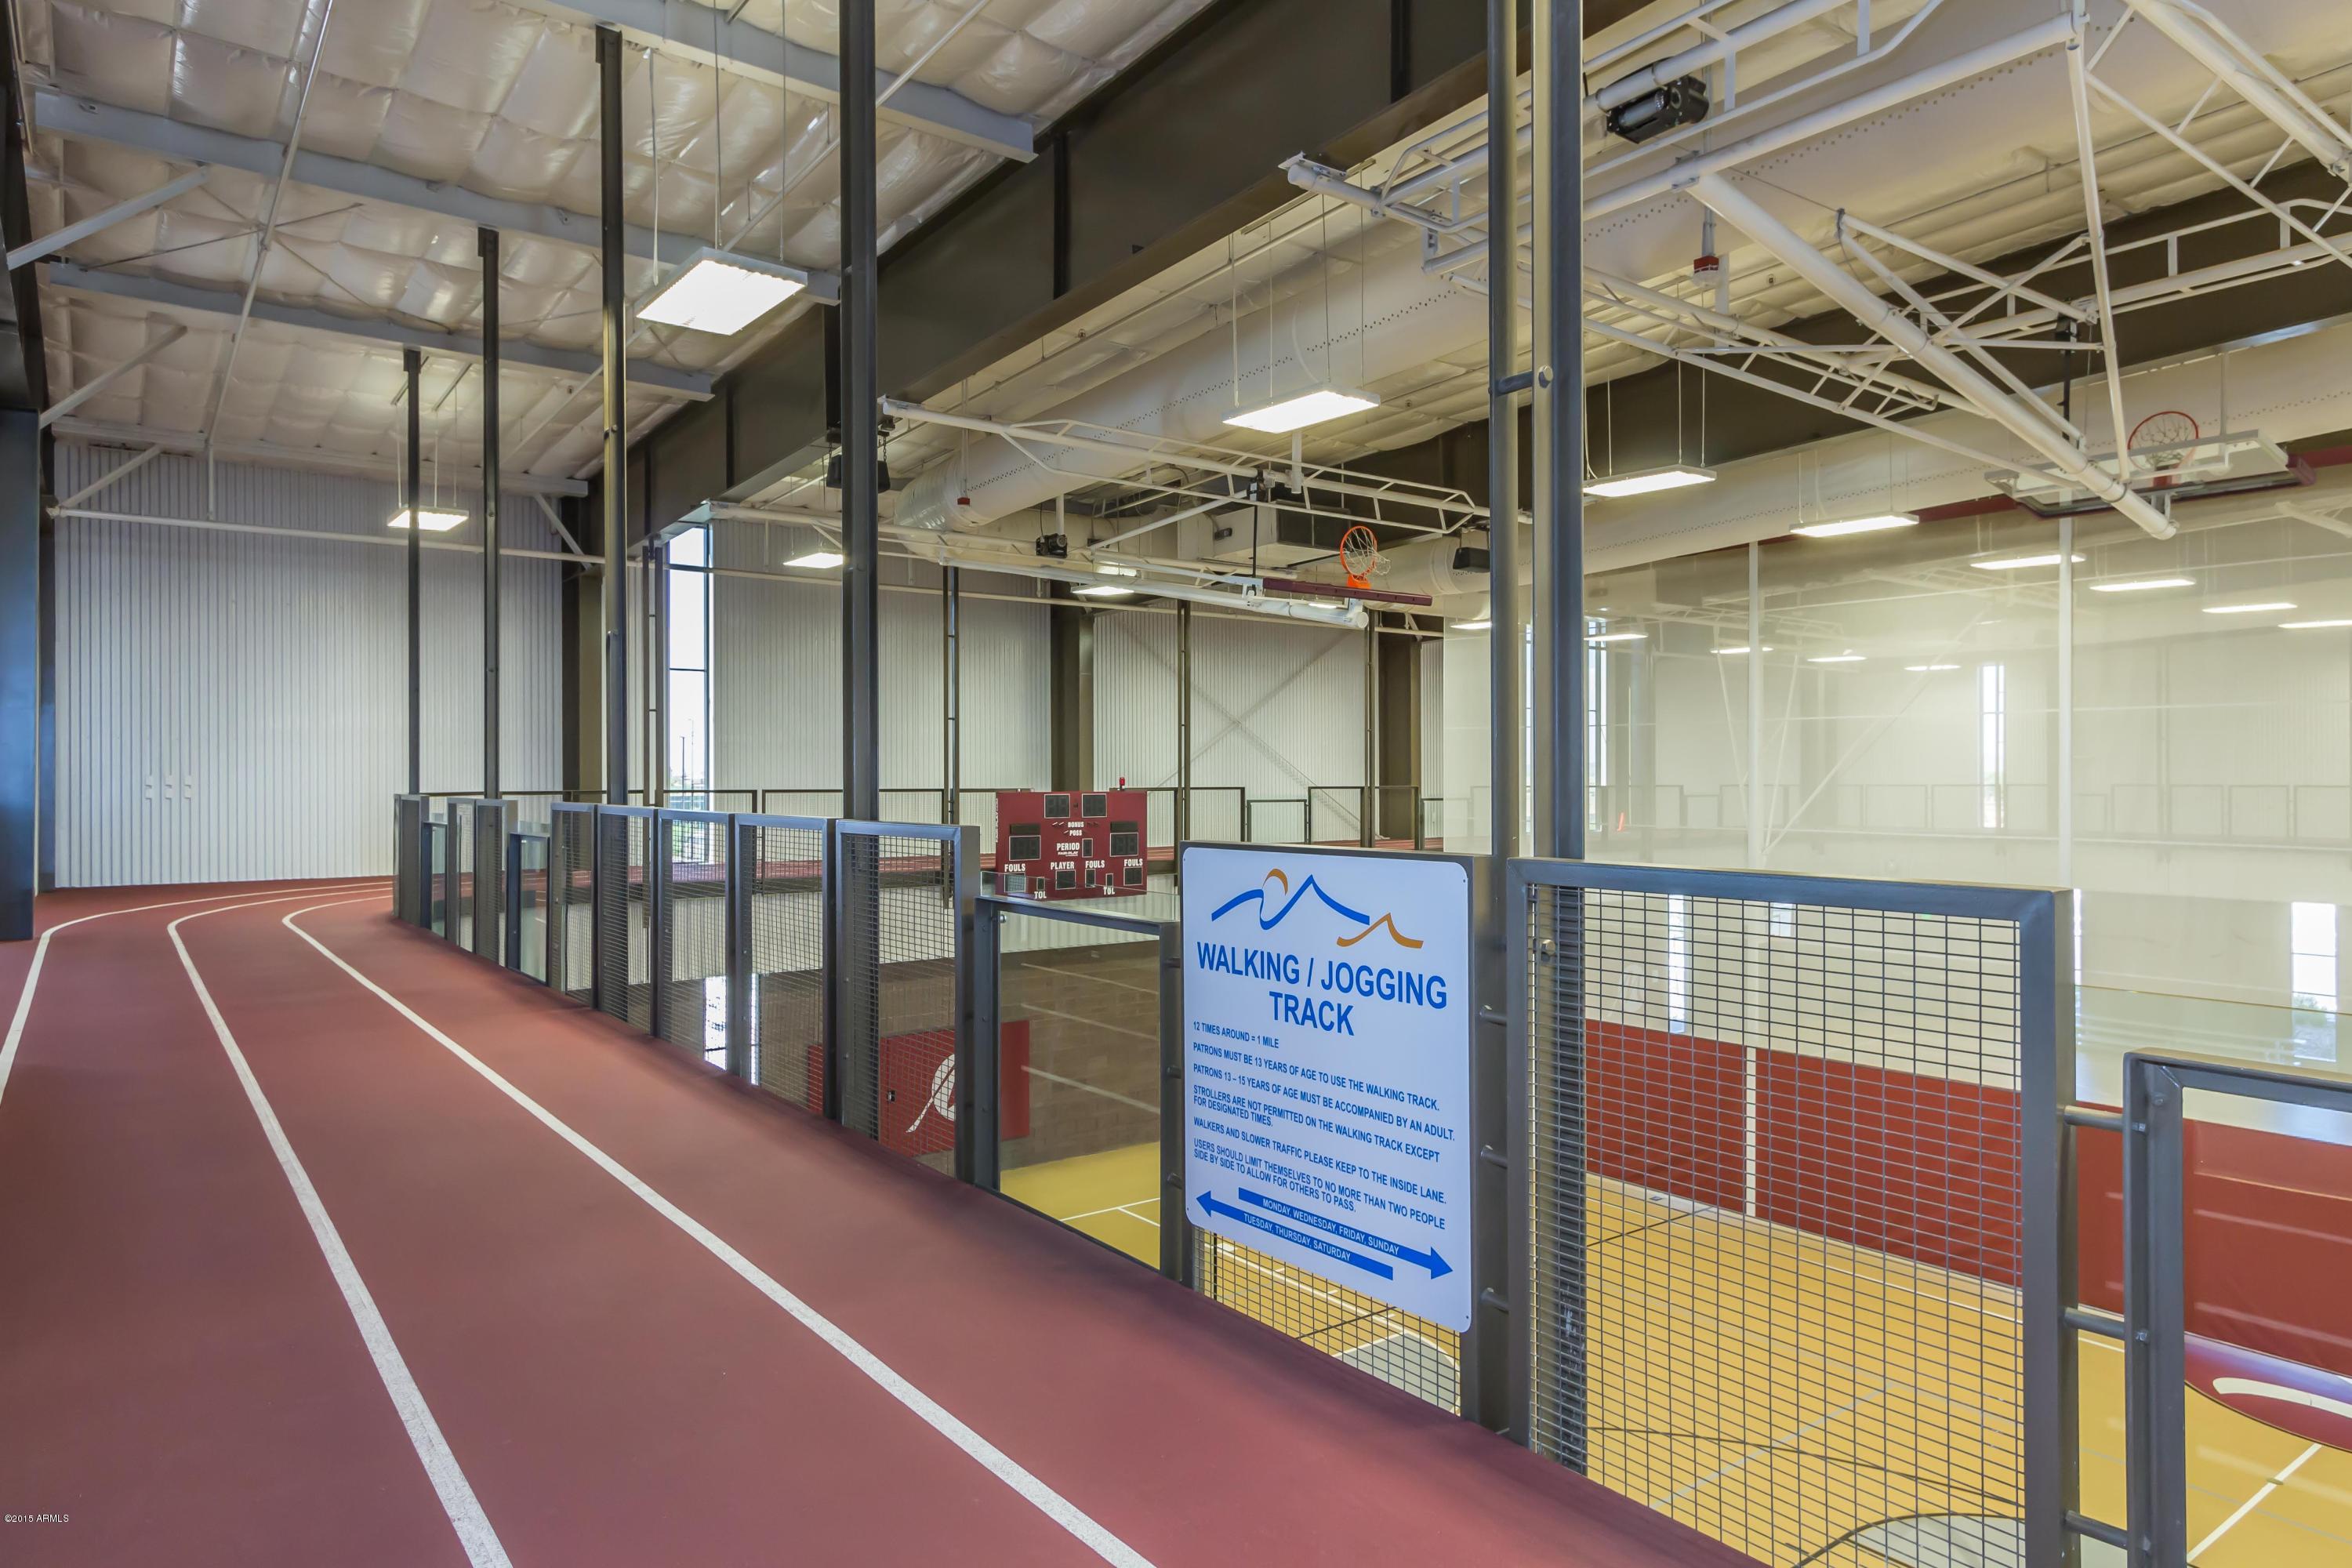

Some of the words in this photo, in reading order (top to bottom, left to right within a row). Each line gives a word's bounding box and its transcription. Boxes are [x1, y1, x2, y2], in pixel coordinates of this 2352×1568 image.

[1004, 863, 1025, 873] FOULS
[1051, 861, 1075, 870] PLAYER
[1056, 842, 1080, 851] PERIOD
[1085, 860, 1105, 869] FOULS
[1124, 858, 1143, 867] FOULS
[1034, 891, 1047, 899] TOL
[1197, 942, 1300, 985] WALKING
[1307, 957, 1314, 987] /
[1321, 960, 1446, 1009] JOGGING
[1193, 1022, 1200, 1031] 12
[1202, 1023, 1220, 1035] TIMES
[1221, 1027, 1250, 1042] AROUND
[1258, 1036, 1261, 1044] 1
[1263, 1036, 1279, 1048] MILE
[1269, 991, 1355, 1036] TRACK
[1193, 1042, 1222, 1058] PATRONS
[1224, 1050, 1242, 1063] MUST
[1244, 1054, 1253, 1065] BE
[1254, 1057, 1262, 1067] 13
[1264, 1059, 1287, 1073] YEARS
[1290, 1065, 1299, 1076] OF
[1301, 1068, 1316, 1080] AGE
[1319, 1072, 1329, 1083] TO
[1330, 1075, 1346, 1088] USE
[1348, 1079, 1363, 1092] THE
[1366, 1083, 1405, 1102] WALKING
[1407, 1093, 1439, 1111] TRACK.
[1193, 1064, 1222, 1079] PATRONS
[1225, 1072, 1232, 1082] 13
[1239, 1076, 1246, 1086] 15
[1247, 1077, 1270, 1091] YEARS
[1272, 1083, 1281, 1094] OF
[1283, 1087, 1298, 1099] AGE
[1301, 1091, 1321, 1105] MUST
[1323, 1097, 1333, 1109] BE
[1334, 1100, 1394, 1124] ACCOMPANIED
[1396, 1116, 1408, 1129] BY
[1410, 1119, 1422, 1132] AN
[1425, 1123, 1454, 1141] ADULT.
[1193, 1095, 1207, 1107] FOR
[1208, 1101, 1249, 1120] DESIGNATED
[1250, 1111, 1273, 1127] TIMES.
[1193, 1085, 1231, 1103] STROLLERS
[1232, 1095, 1246, 1108] ARE
[1247, 1100, 1261, 1112] NOT
[1264, 1104, 1304, 1123] PERMITTED
[1305, 1116, 1316, 1127] ON
[1319, 1119, 1333, 1132] THE
[1335, 1123, 1372, 1144] WALKING
[1374, 1134, 1403, 1152] TRACK
[1405, 1143, 1439, 1163] EXCEPT
[1194, 1116, 1225, 1134] WALKERS
[1225, 1127, 1240, 1139] AND
[1242, 1131, 1270, 1149] SLOWER
[1272, 1140, 1302, 1159] TRAFFIC
[1305, 1150, 1333, 1168] PLEASE
[1336, 1160, 1356, 1173] KEEP
[1359, 1167, 1370, 1179] TO
[1372, 1171, 1388, 1185] THE
[1390, 1176, 1417, 1195] INSIDE
[1421, 1186, 1446, 1204] LANE.
[1194, 1149, 1208, 1162] SIDE
[1210, 1154, 1218, 1164] BY
[1220, 1157, 1234, 1171] SIDE
[1236, 1163, 1245, 1174] TO
[1247, 1166, 1271, 1183] ALLOW
[1273, 1174, 1287, 1189] FOR
[1289, 1180, 1319, 1200] OTHERS
[1322, 1192, 1332, 1203] TO
[1334, 1196, 1356, 1212] PASS.
[1194, 1138, 1215, 1152] USERS
[1217, 1145, 1243, 1163] SHOULD
[1245, 1154, 1261, 1168] LIMIT
[1264, 1160, 1311, 1185] THEMSELVES
[1313, 1177, 1323, 1189] TO
[1325, 1180, 1336, 1193] NO
[1338, 1185, 1361, 1202] MORE
[1363, 1192, 1386, 1210] THAN
[1388, 1201, 1407, 1217] TWO
[1410, 1208, 1445, 1230] PEOPLE
[1243, 1213, 1274, 1233] TUESDAY,
[1275, 1225, 1312, 1247] THURSDAY,
[1313, 1240, 1351, 1261] SATURDAY
[1262, 1198, 1292, 1217] MONDAY,
[1293, 1210, 1338, 1234] WEDNESDAY,
[1339, 1226, 1367, 1244] FRIDAY,
[1368, 1236, 1399, 1255] SUNDAY
